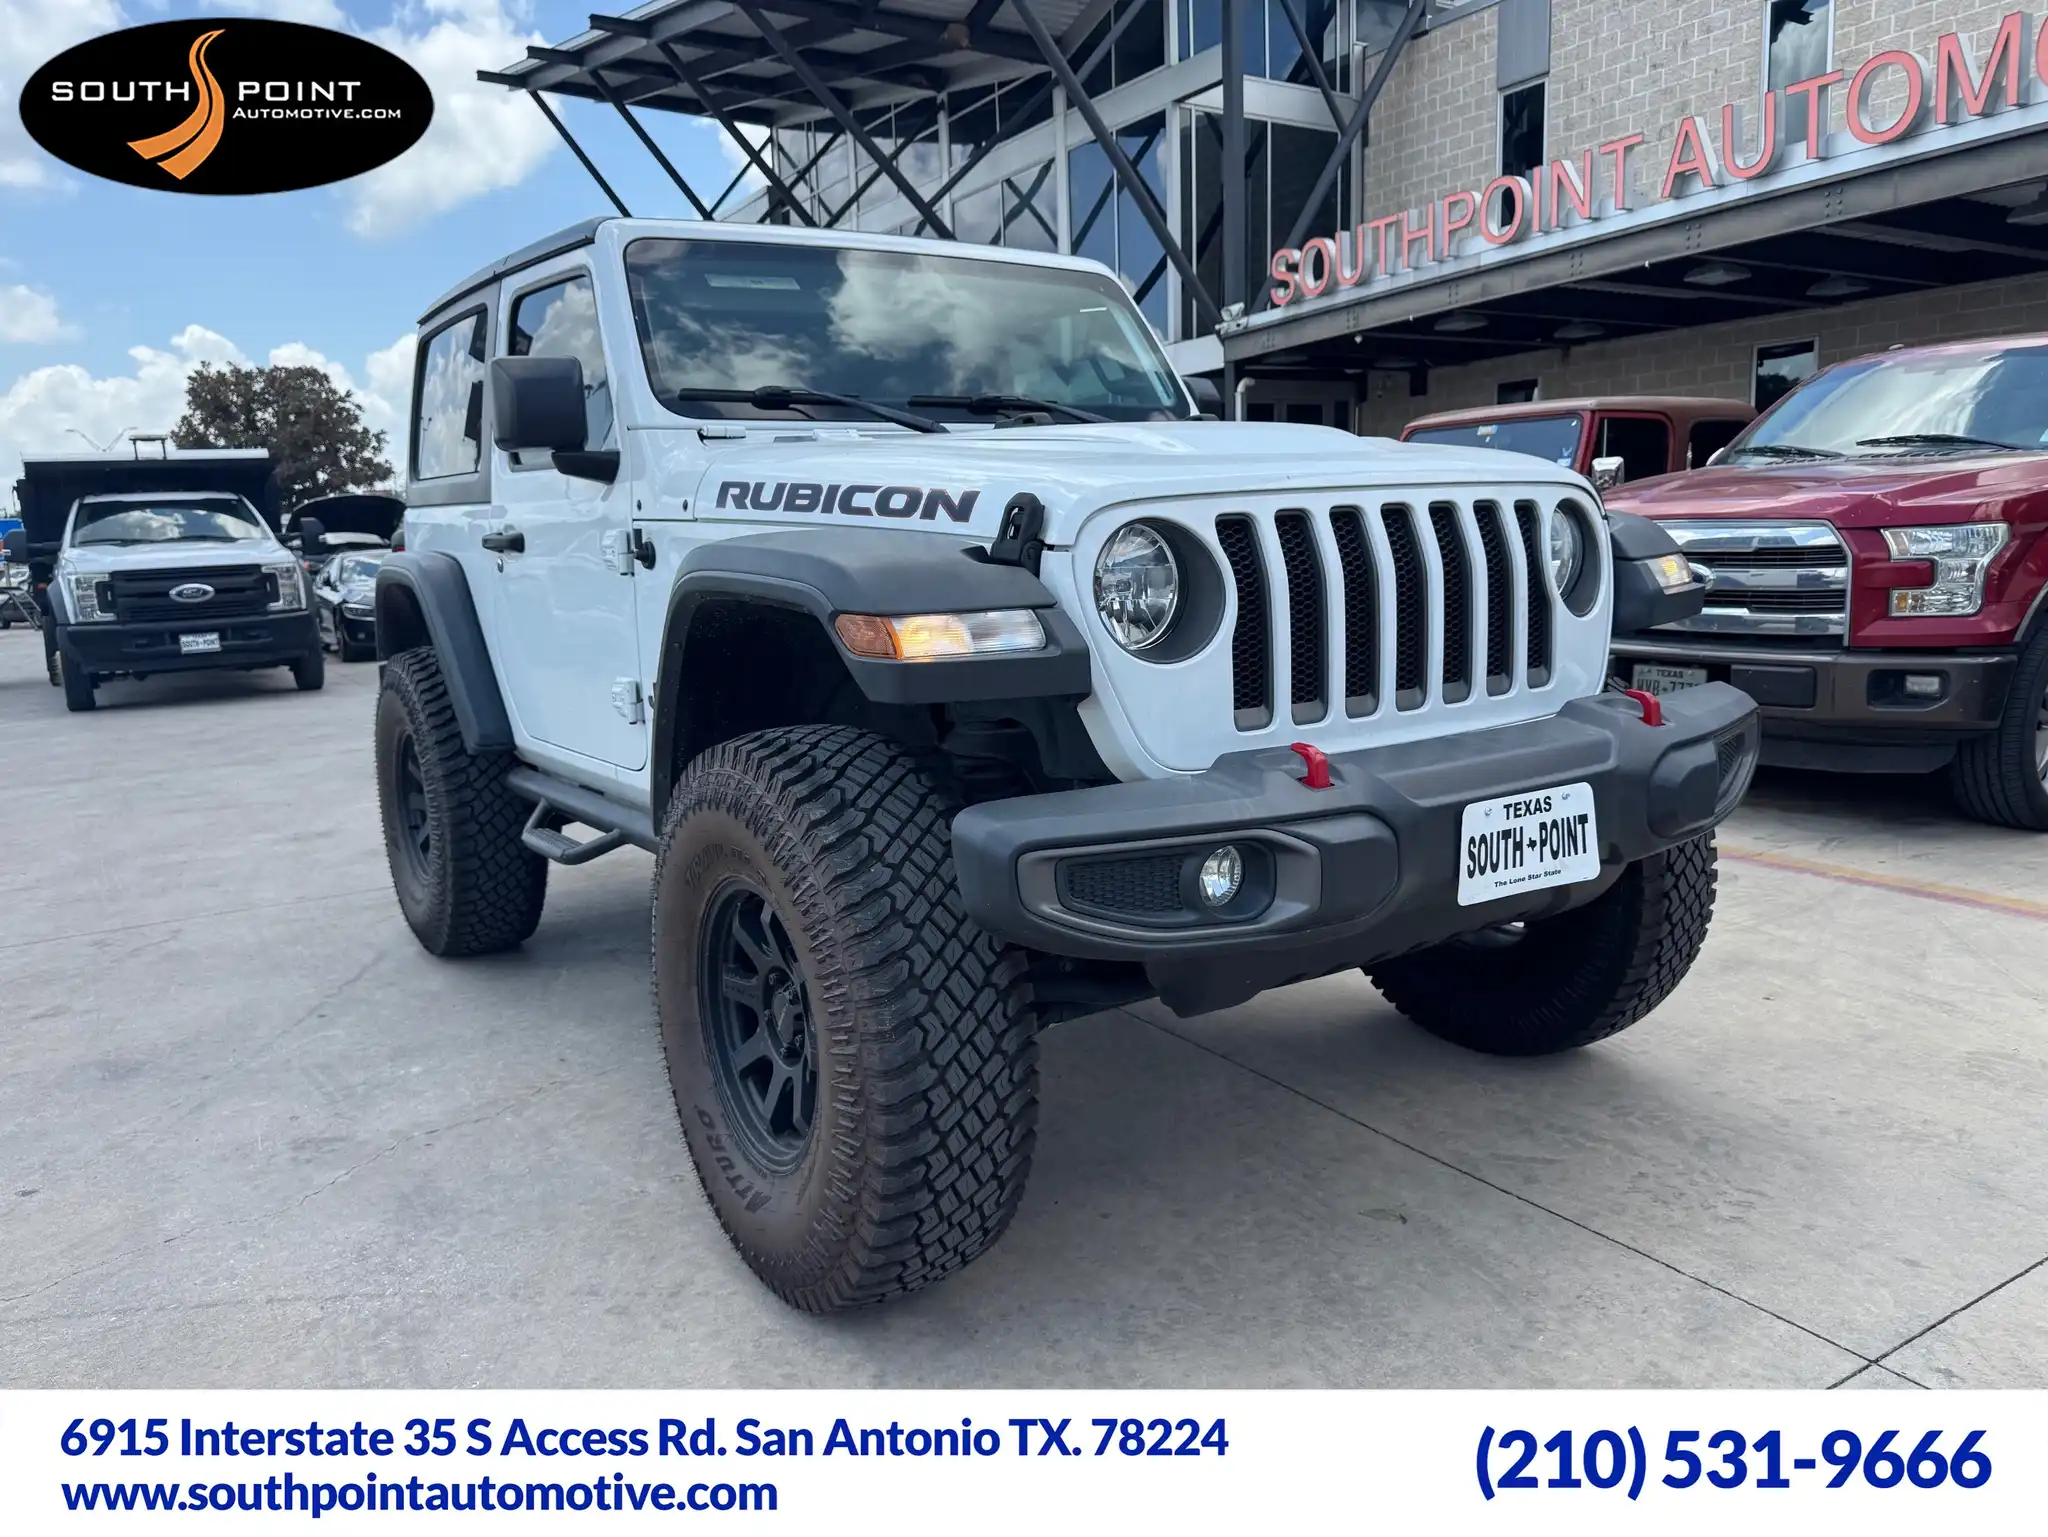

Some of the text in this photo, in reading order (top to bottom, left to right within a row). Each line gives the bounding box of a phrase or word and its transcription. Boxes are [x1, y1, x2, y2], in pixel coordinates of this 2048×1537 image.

[1270, 11, 2048, 306] SOUTHPOINT AUTOM
[715, 480, 981, 523] RUBICON
[1656, 669, 1684, 679] TEXAS
[1503, 795, 1552, 820] TEXAS
[1467, 813, 1589, 879] SOUTH POINT
[1494, 869, 1562, 888] The Lone Star State
[693, 1103, 773, 1214] ATTURO
